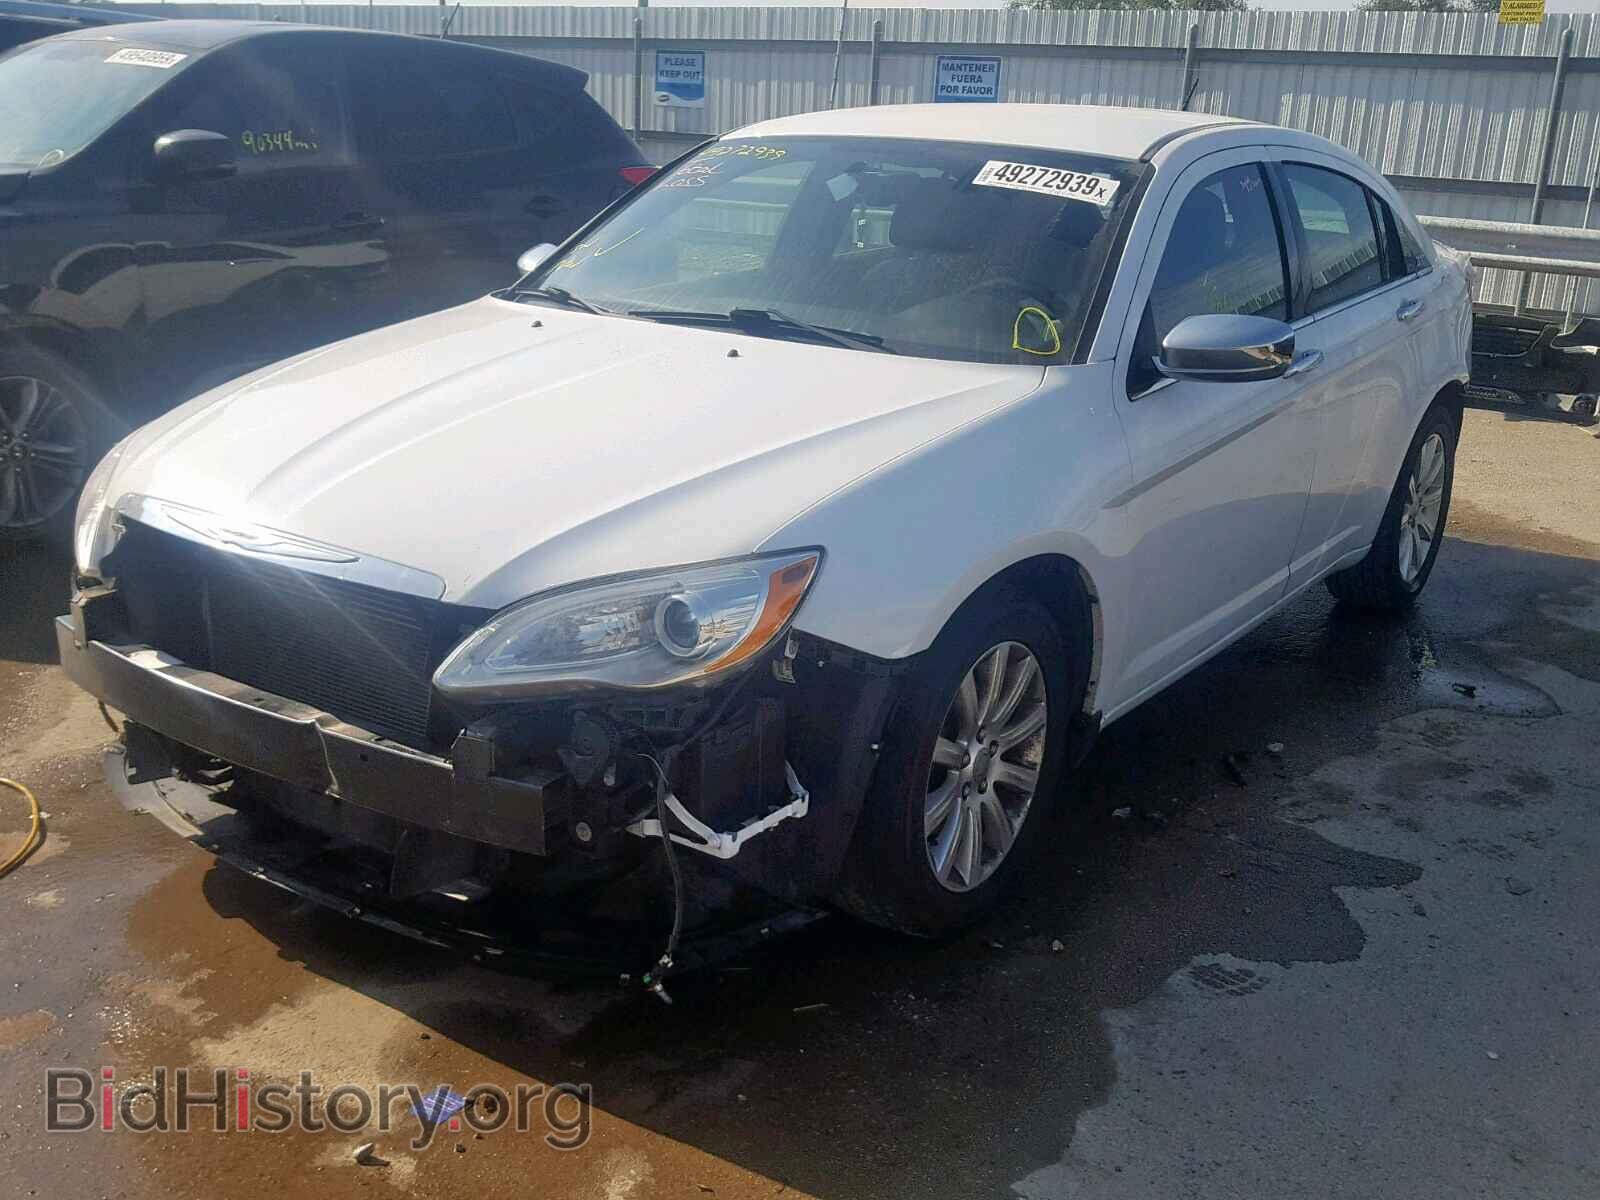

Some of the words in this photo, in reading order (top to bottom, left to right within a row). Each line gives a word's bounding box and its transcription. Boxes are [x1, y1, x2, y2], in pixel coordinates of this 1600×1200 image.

[664, 57, 697, 67] PLEASE
[941, 63, 996, 73] MANTENER
[659, 70, 681, 78] KEEP
[682, 71, 701, 80] OUT
[951, 74, 983, 84] FUERA
[940, 84, 960, 94] POR
[961, 85, 993, 95] FAVOR
[993, 163, 1100, 196] 49272939
